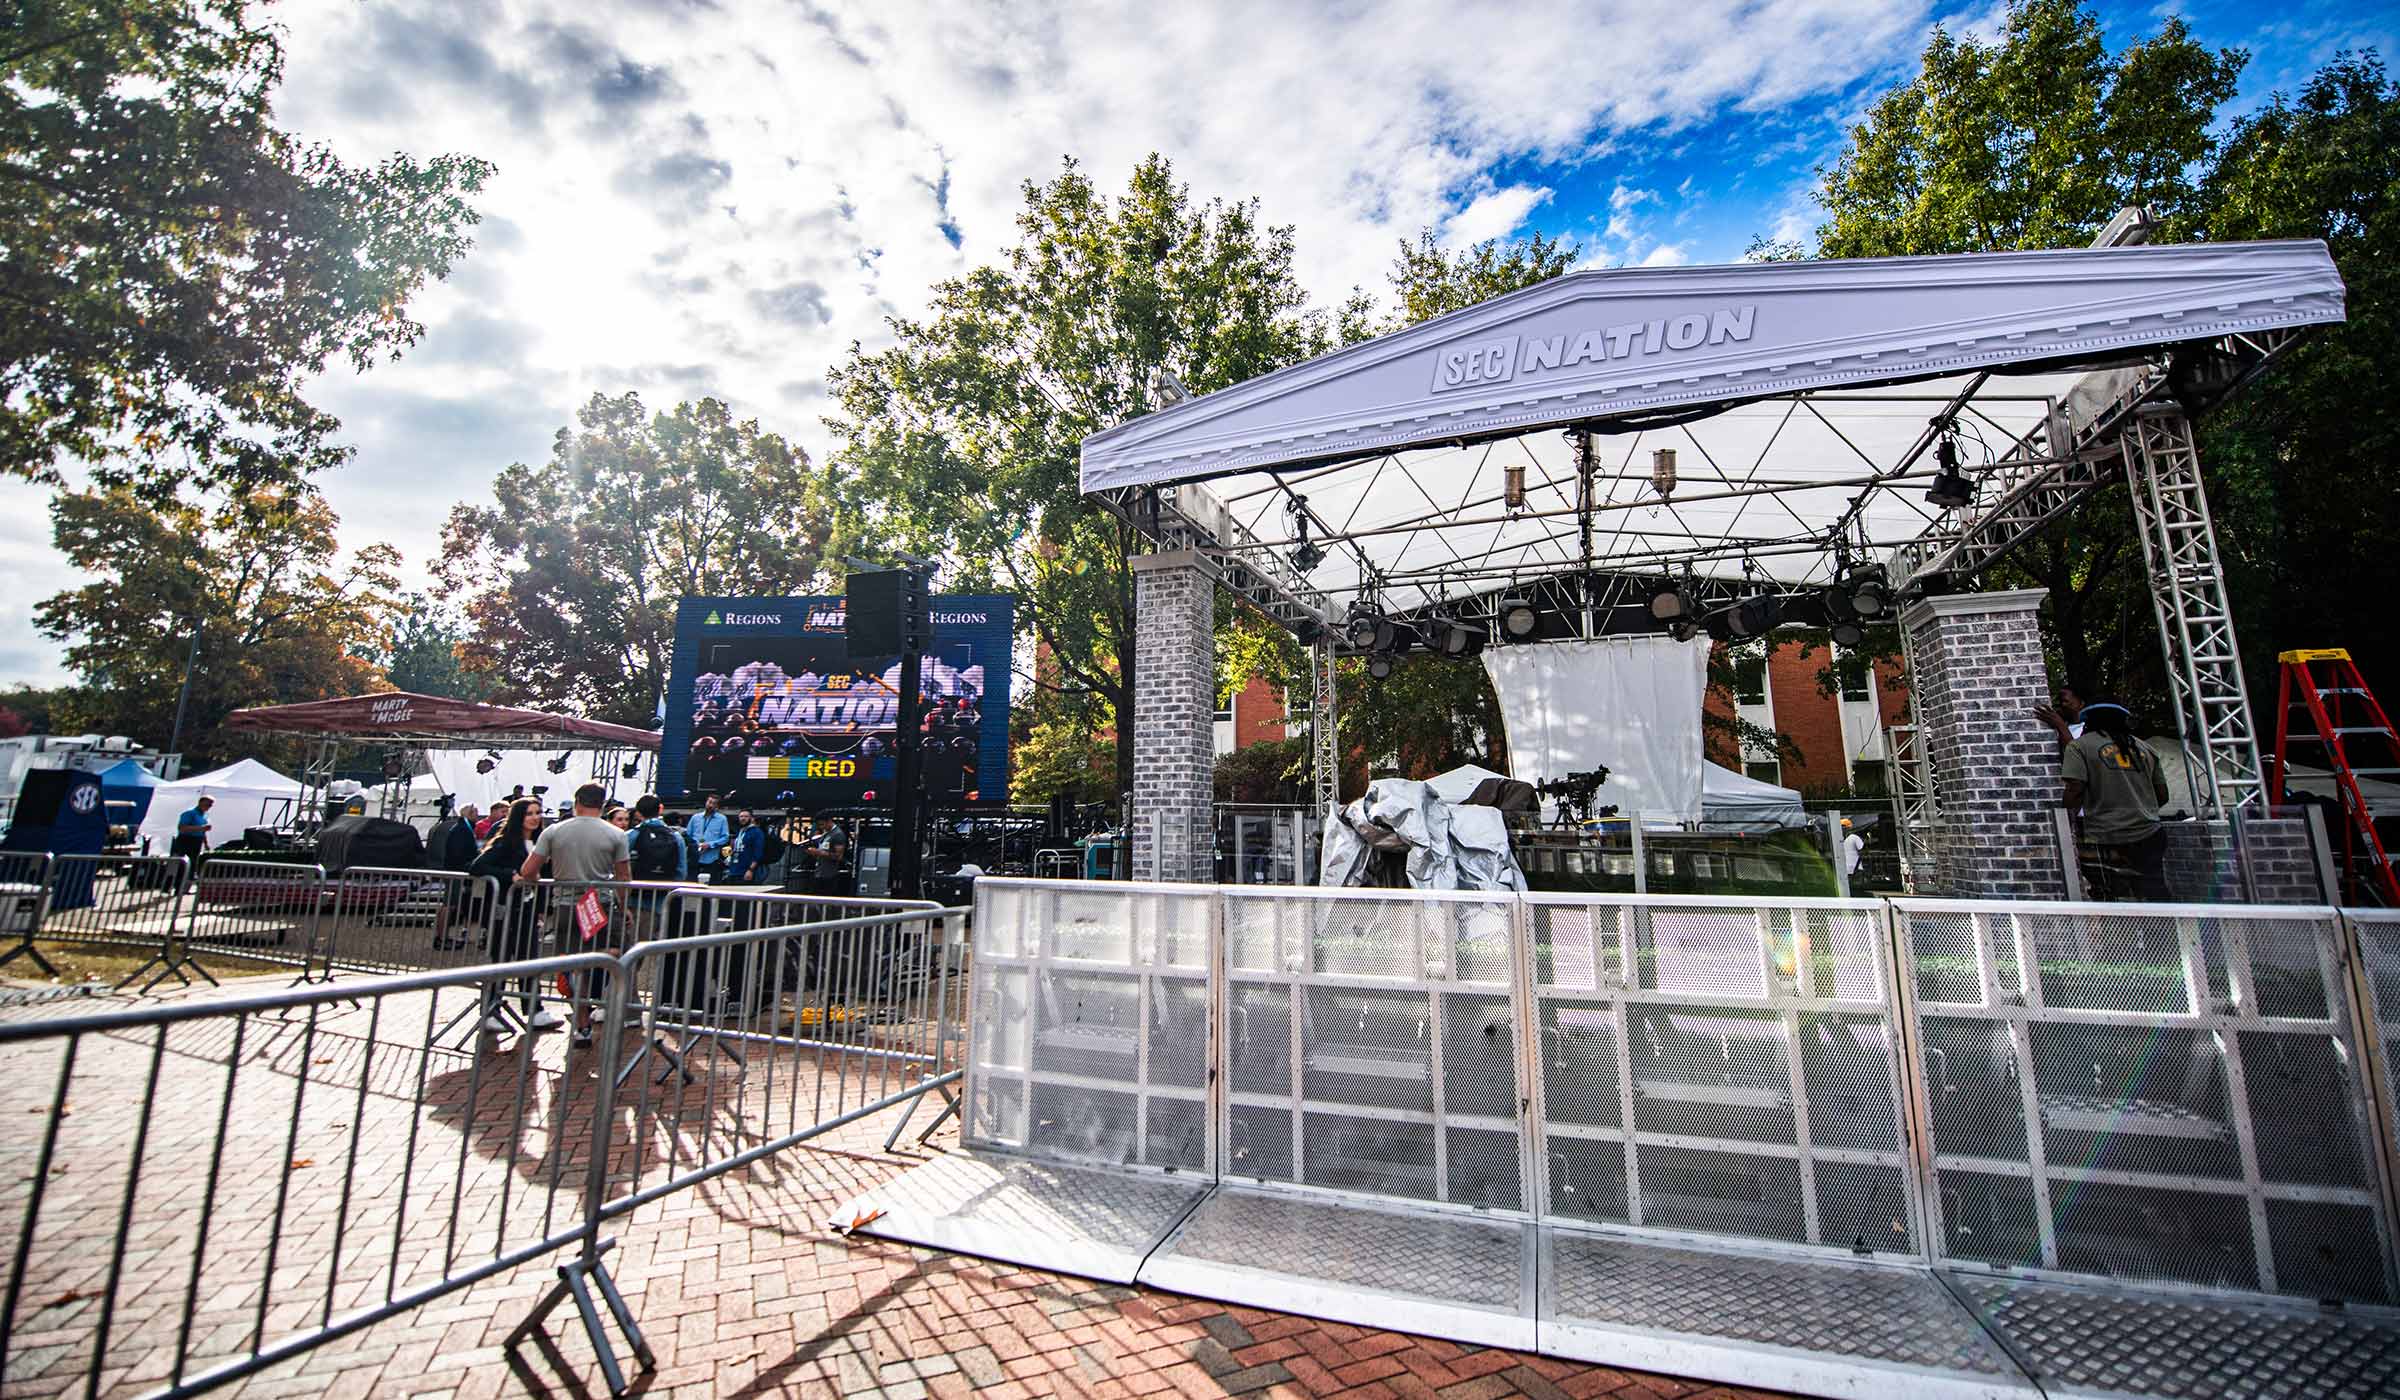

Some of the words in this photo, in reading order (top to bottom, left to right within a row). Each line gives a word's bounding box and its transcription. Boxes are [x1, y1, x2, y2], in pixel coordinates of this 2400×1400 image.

[1445, 343, 1505, 386] SEC
[1522, 303, 1758, 373] NATION
[725, 612, 782, 625] REGIONS
[811, 612, 846, 627] NAT
[826, 674, 851, 689] SEC
[371, 698, 409, 713] MARTY
[806, 759, 856, 778] RED
[73, 785, 98, 810] SEC
